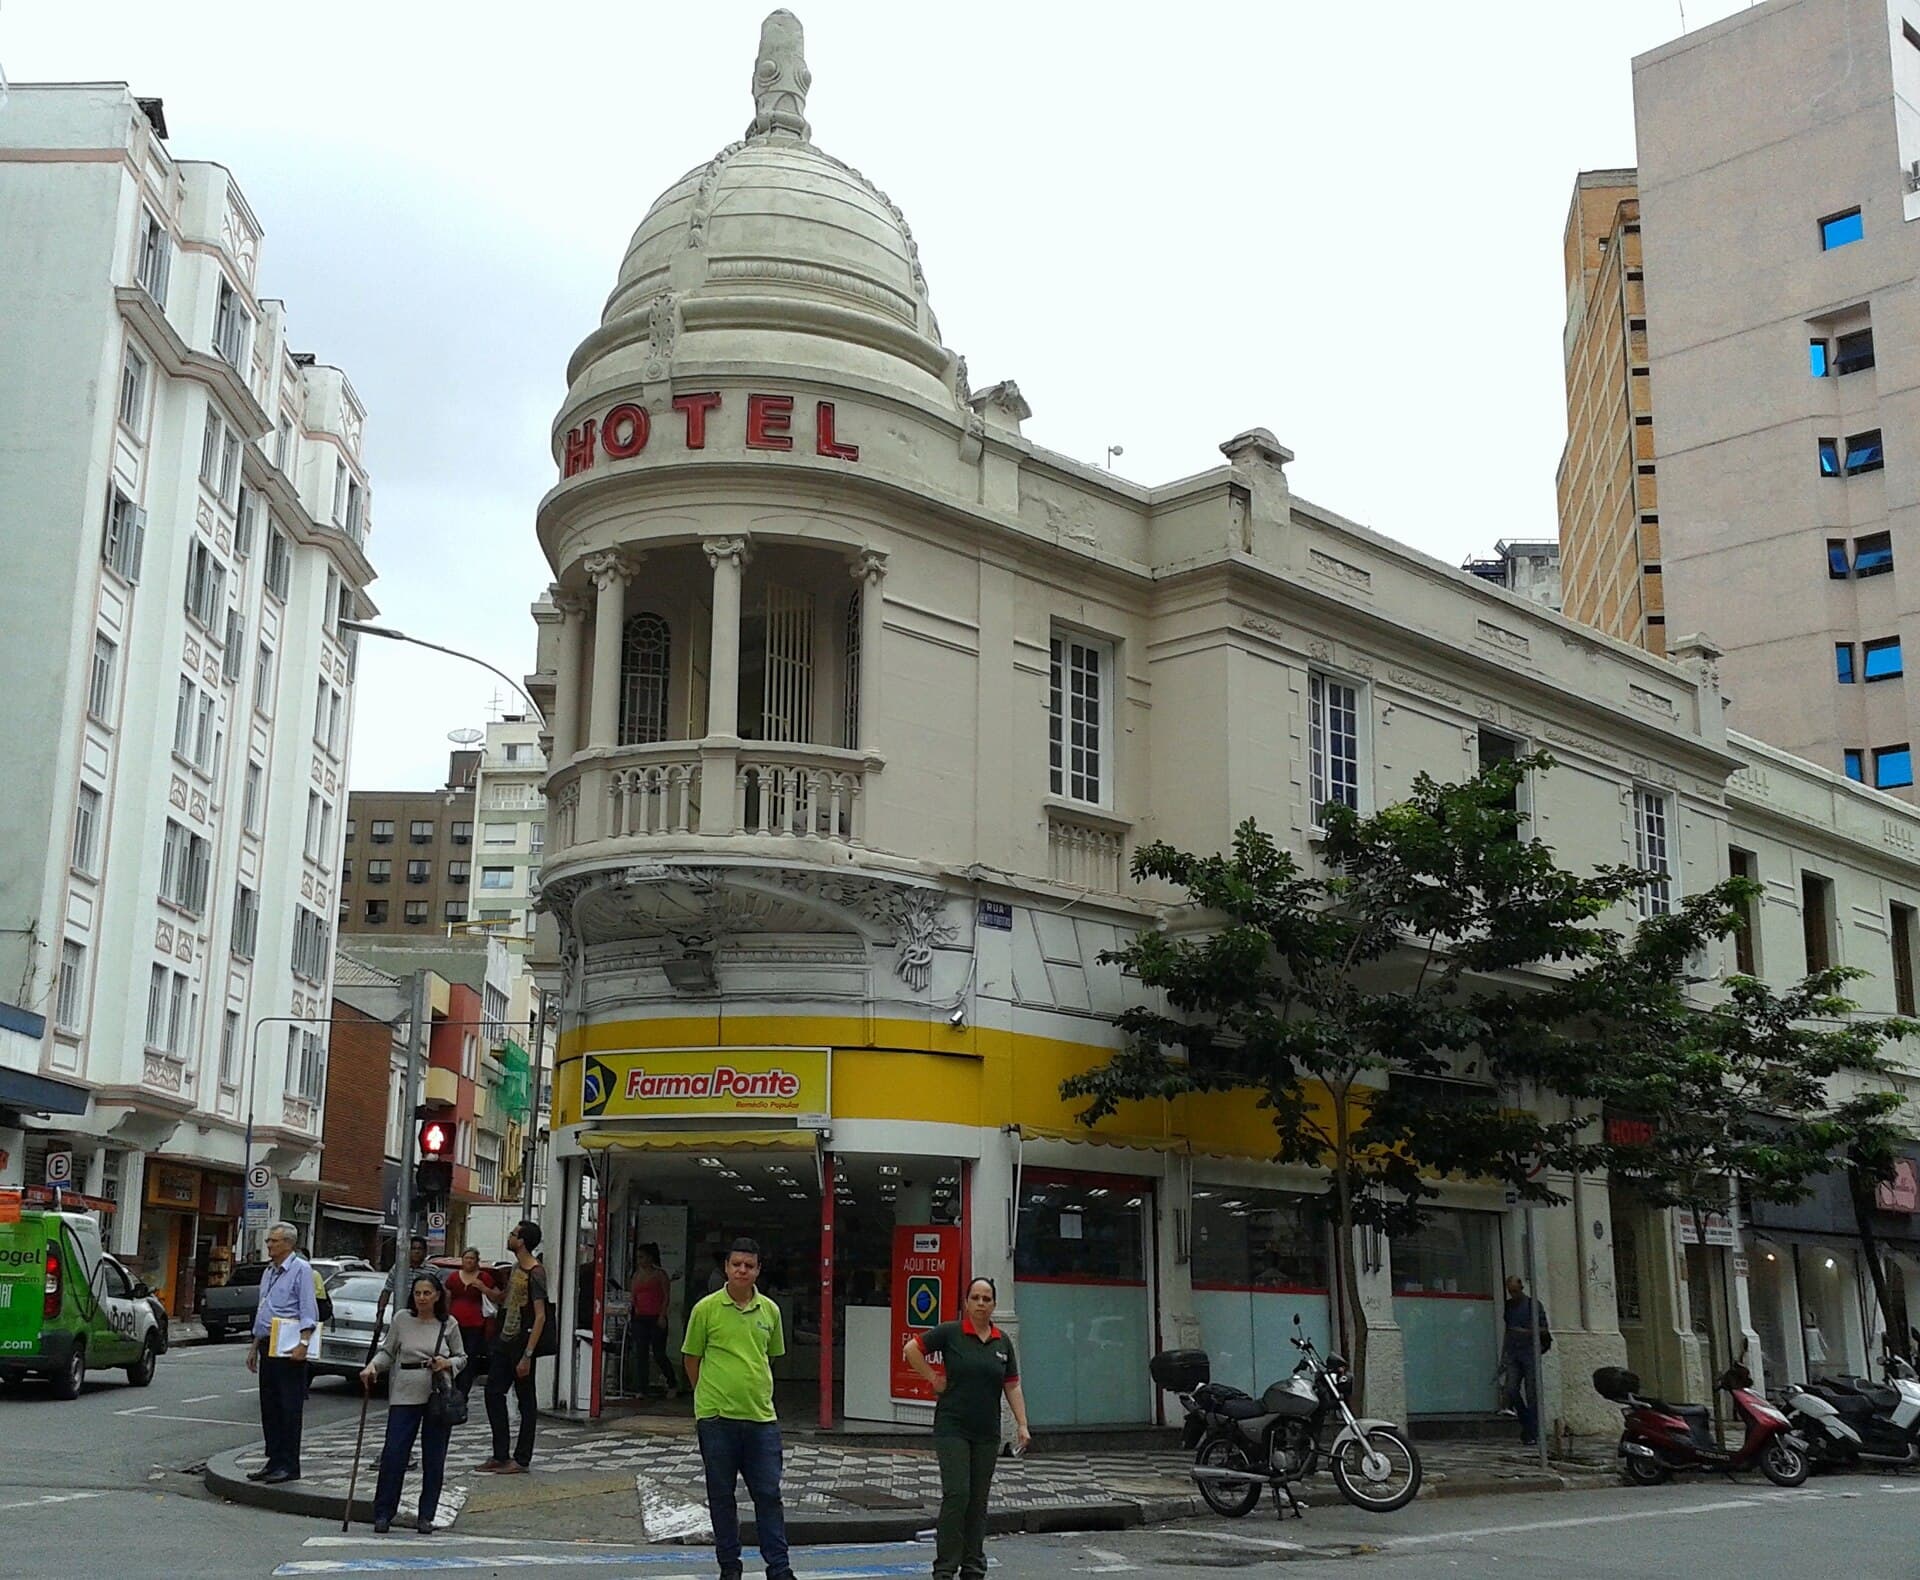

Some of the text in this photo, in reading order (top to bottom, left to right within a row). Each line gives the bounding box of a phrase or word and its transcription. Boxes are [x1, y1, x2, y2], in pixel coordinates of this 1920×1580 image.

[563, 391, 860, 479] HOTEL
[986, 902, 1005, 914] RUA
[626, 1066, 799, 1099] Farma Ponte
[55, 1160, 64, 1175] E
[255, 1172, 263, 1183] E
[903, 1258, 946, 1272] AQUI TEM
